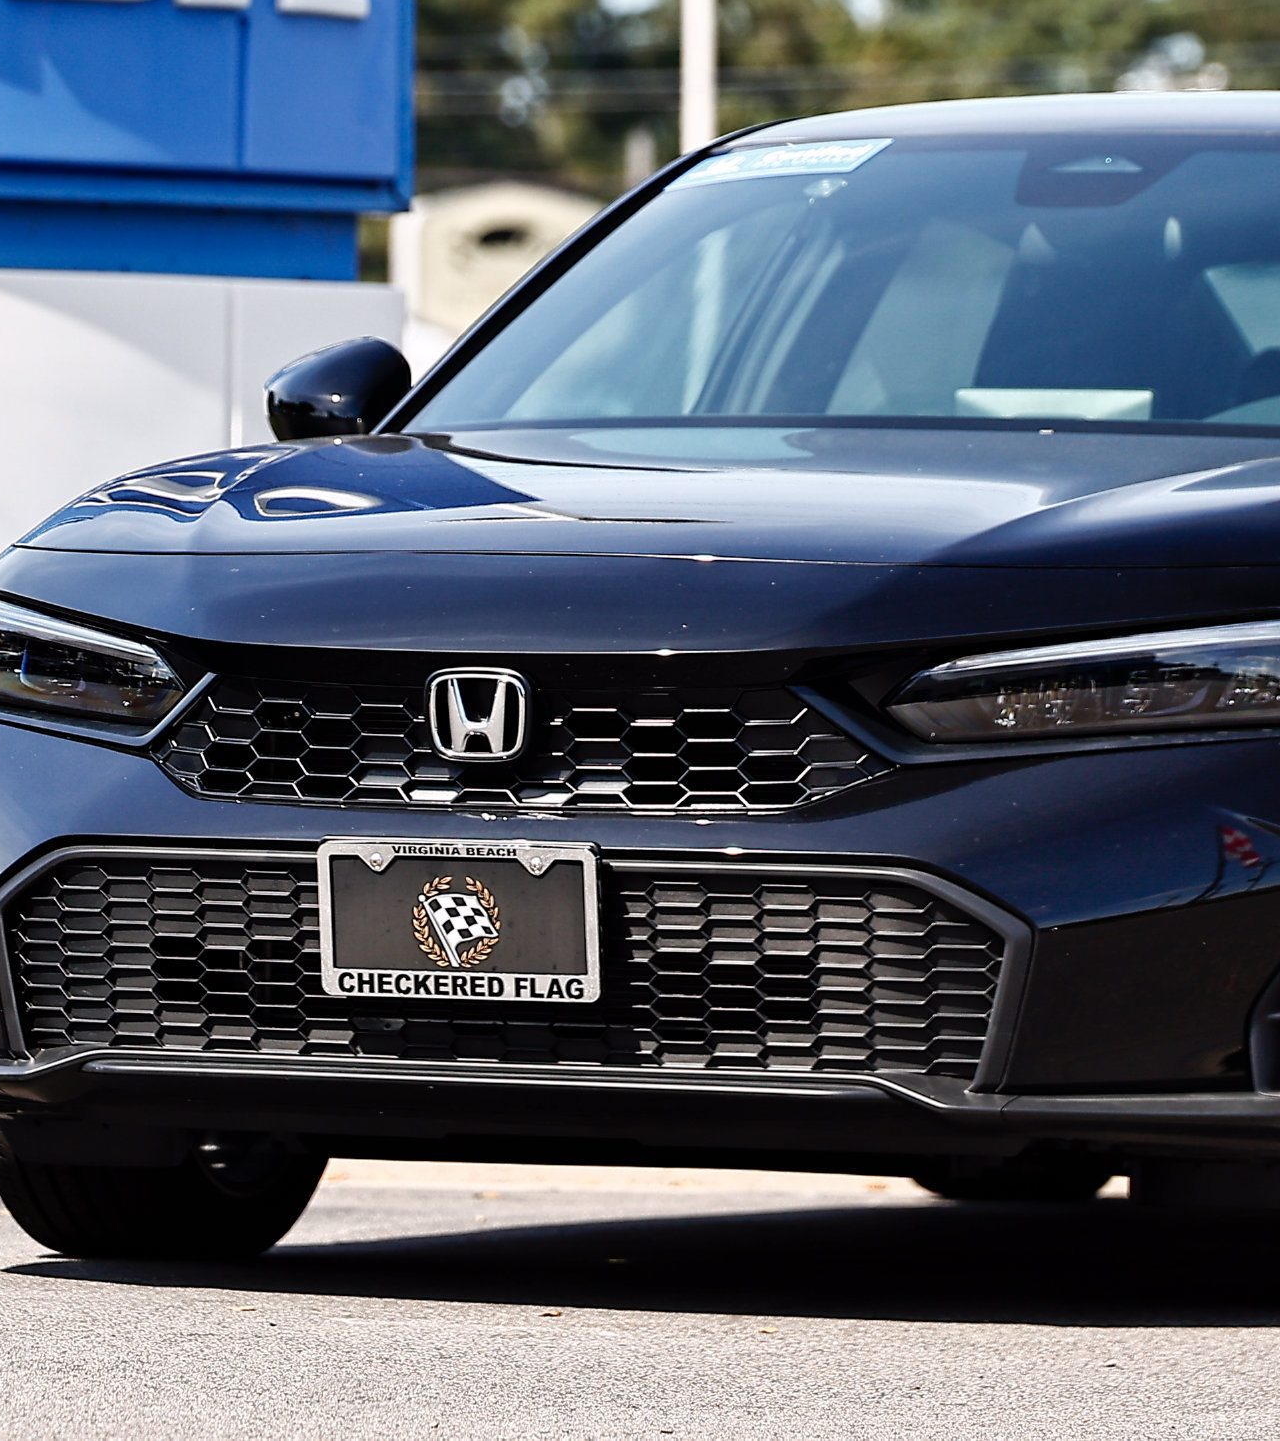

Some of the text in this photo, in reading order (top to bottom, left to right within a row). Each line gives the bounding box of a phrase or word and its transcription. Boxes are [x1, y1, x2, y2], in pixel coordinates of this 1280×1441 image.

[392, 845, 518, 857] VIRGINIA BEACH
[337, 971, 585, 1000] CHECKERED FLAG
